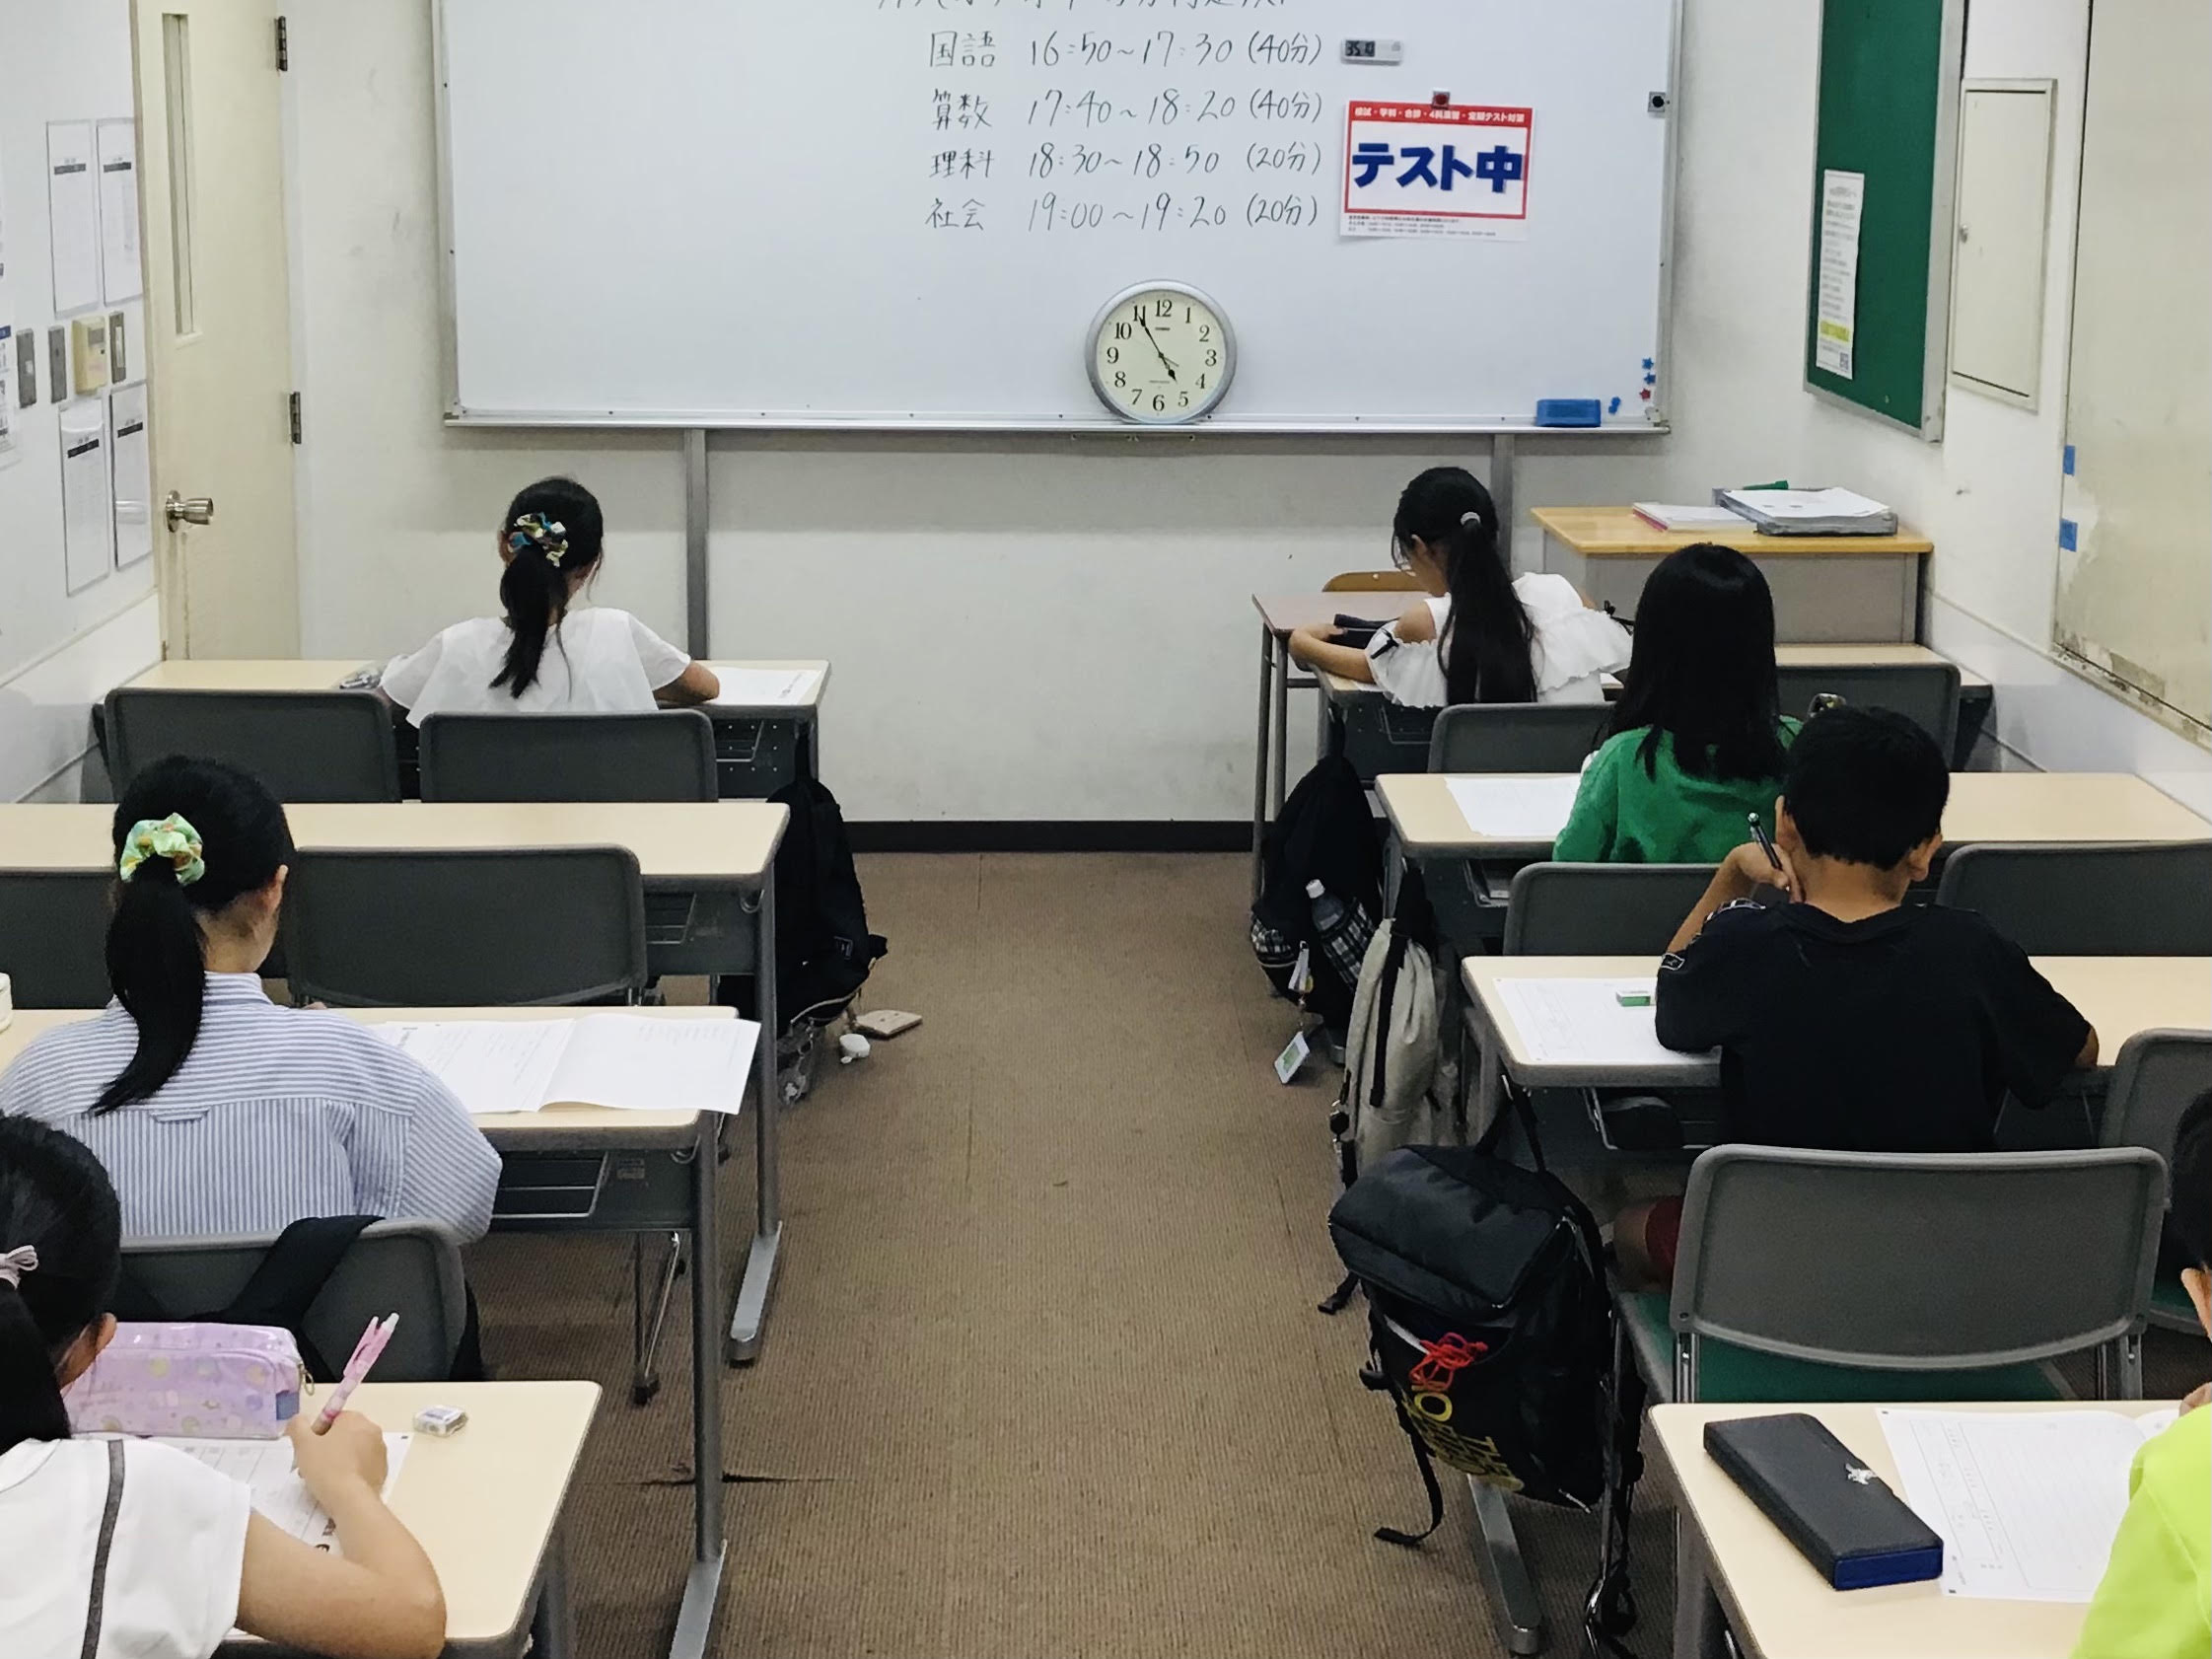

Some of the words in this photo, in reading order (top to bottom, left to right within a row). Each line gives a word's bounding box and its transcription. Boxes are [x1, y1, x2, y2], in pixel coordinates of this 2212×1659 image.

[929, 30, 996, 67] 国語
[932, 88, 992, 130] 算数
[929, 148, 994, 180] 理科
[1352, 143, 1523, 193] テスト中
[925, 198, 985, 231] 社会
[1155, 299, 1173, 318] 12
[1185, 307, 1191, 324] 1
[1114, 323, 1132, 339] 10
[1199, 325, 1210, 342] 2
[1106, 347, 1119, 364] 9
[1205, 349, 1217, 366] 3
[1114, 371, 1126, 388] 8
[1195, 373, 1205, 389] 4
[1131, 389, 1142, 405] 7
[1152, 395, 1165, 411] 6
[1177, 392, 1188, 407] 5
